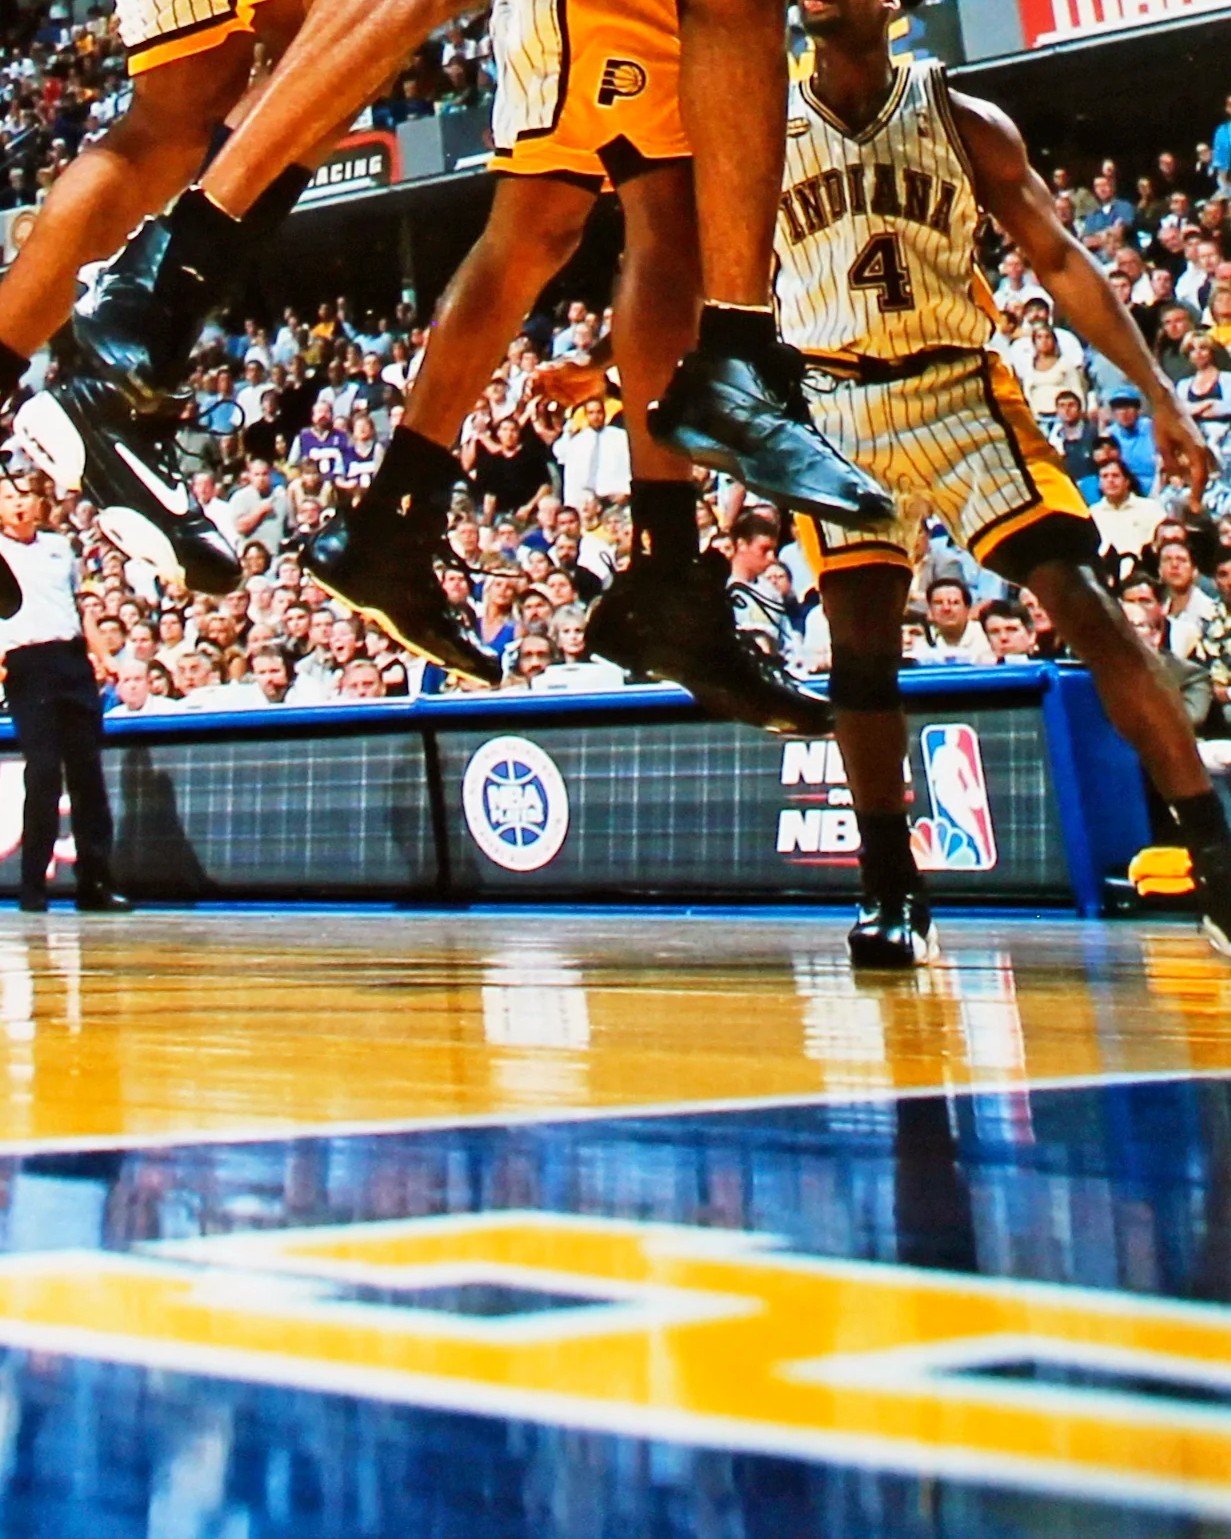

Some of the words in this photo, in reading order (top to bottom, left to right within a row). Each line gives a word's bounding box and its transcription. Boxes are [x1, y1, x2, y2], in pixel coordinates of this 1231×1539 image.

[307, 154, 383, 189] ACING
[778, 162, 958, 246] INDIANA
[847, 232, 916, 313] 4
[776, 809, 863, 853] NB
